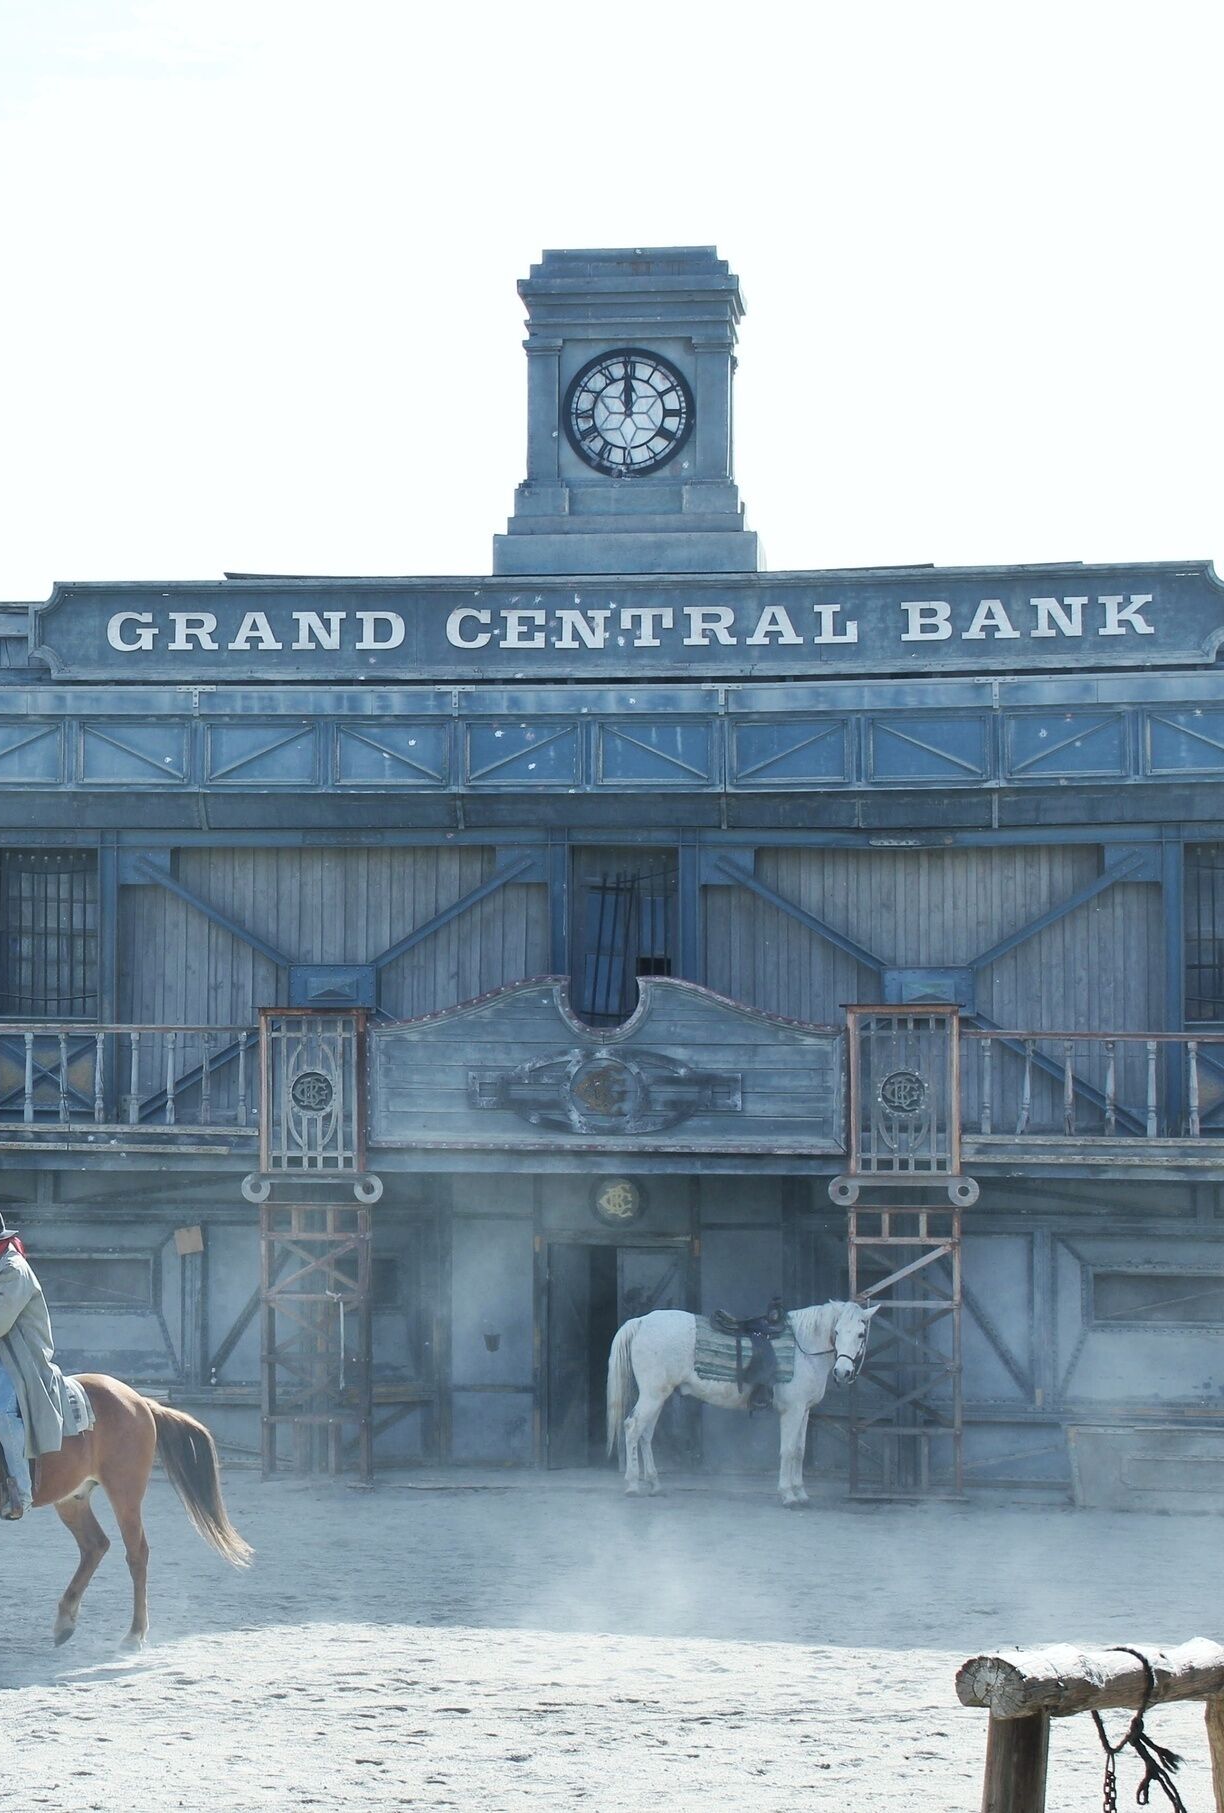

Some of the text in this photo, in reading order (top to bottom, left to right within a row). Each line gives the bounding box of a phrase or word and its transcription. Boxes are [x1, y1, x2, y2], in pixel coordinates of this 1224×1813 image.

[107, 595, 1156, 652] GRAND CENTRAL BANK
